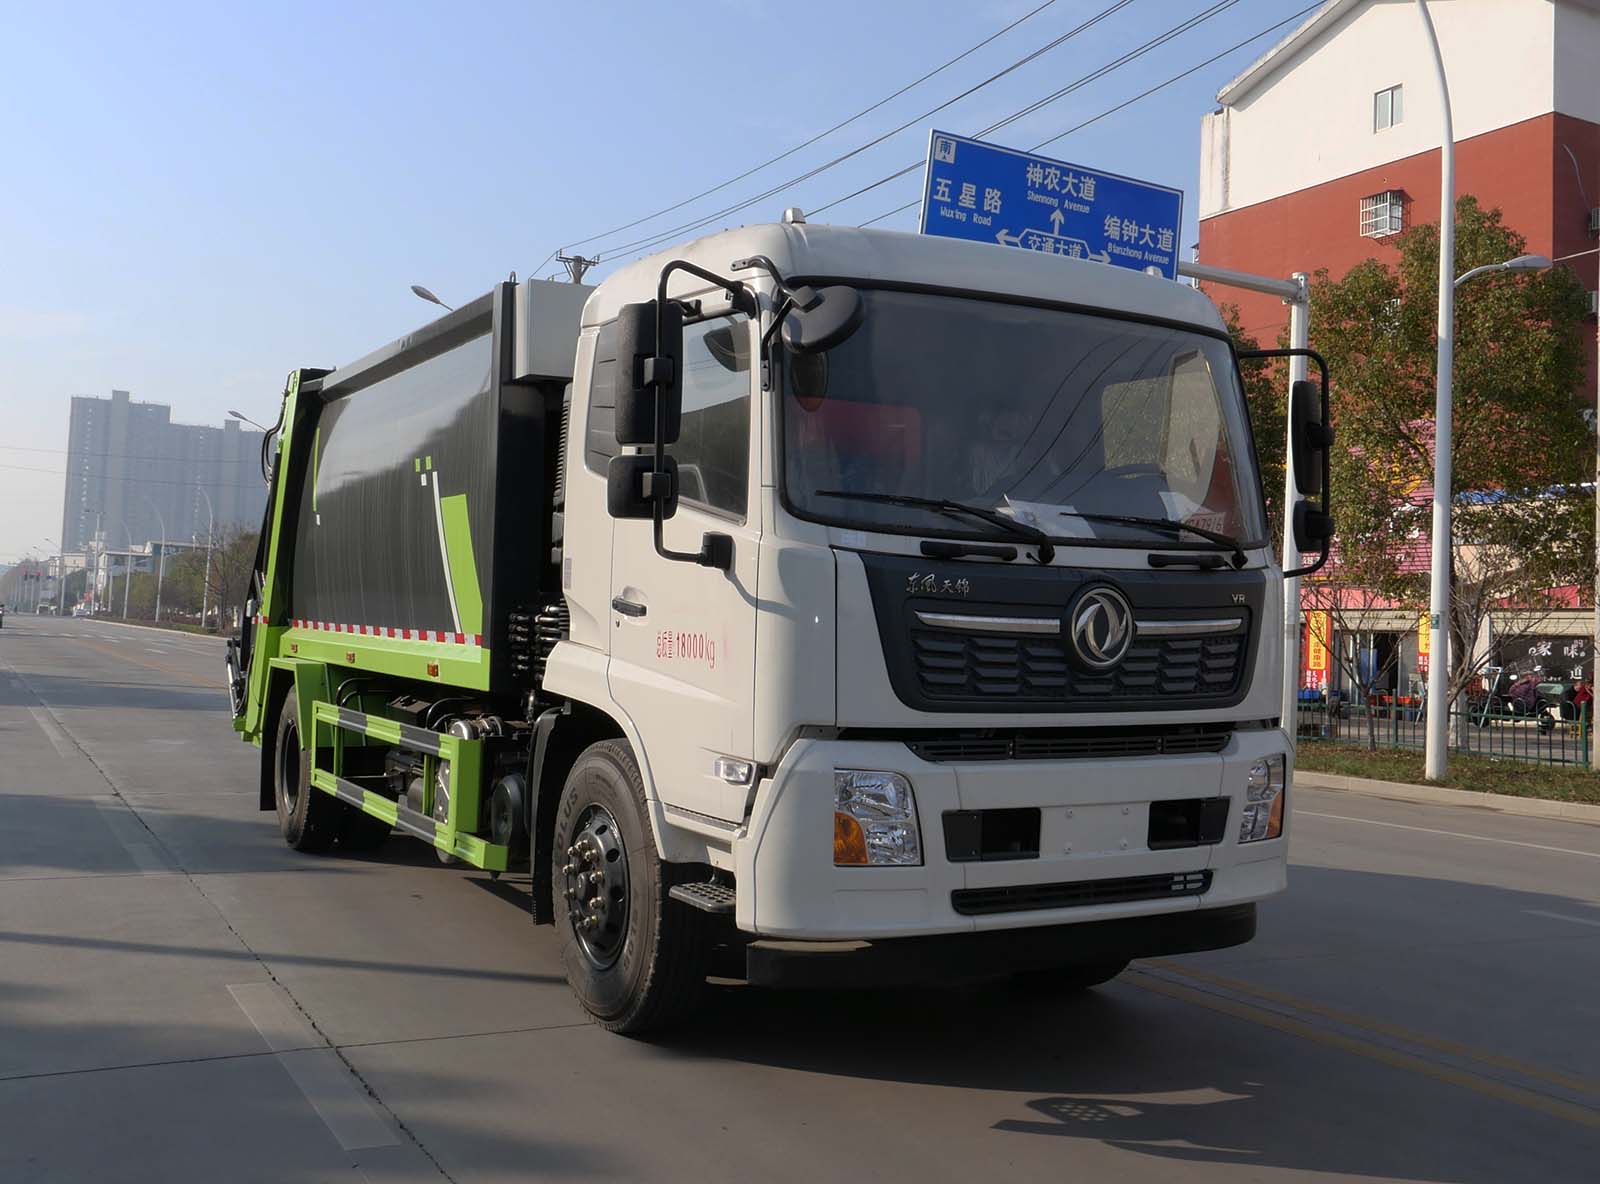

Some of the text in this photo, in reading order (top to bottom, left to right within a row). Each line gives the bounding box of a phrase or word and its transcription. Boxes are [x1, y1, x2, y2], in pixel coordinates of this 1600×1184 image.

[1026, 163, 1097, 202] 神农大道
[933, 177, 1002, 214] 五星路
[1027, 190, 1091, 214] Shennong Avenue
[940, 205, 993, 227] Wuxing Road
[1103, 215, 1175, 253] 编钟大道
[1028, 234, 1082, 259] 交通大道
[1107, 241, 1170, 265] Bianzhong Avenue
[1231, 592, 1246, 605] VR
